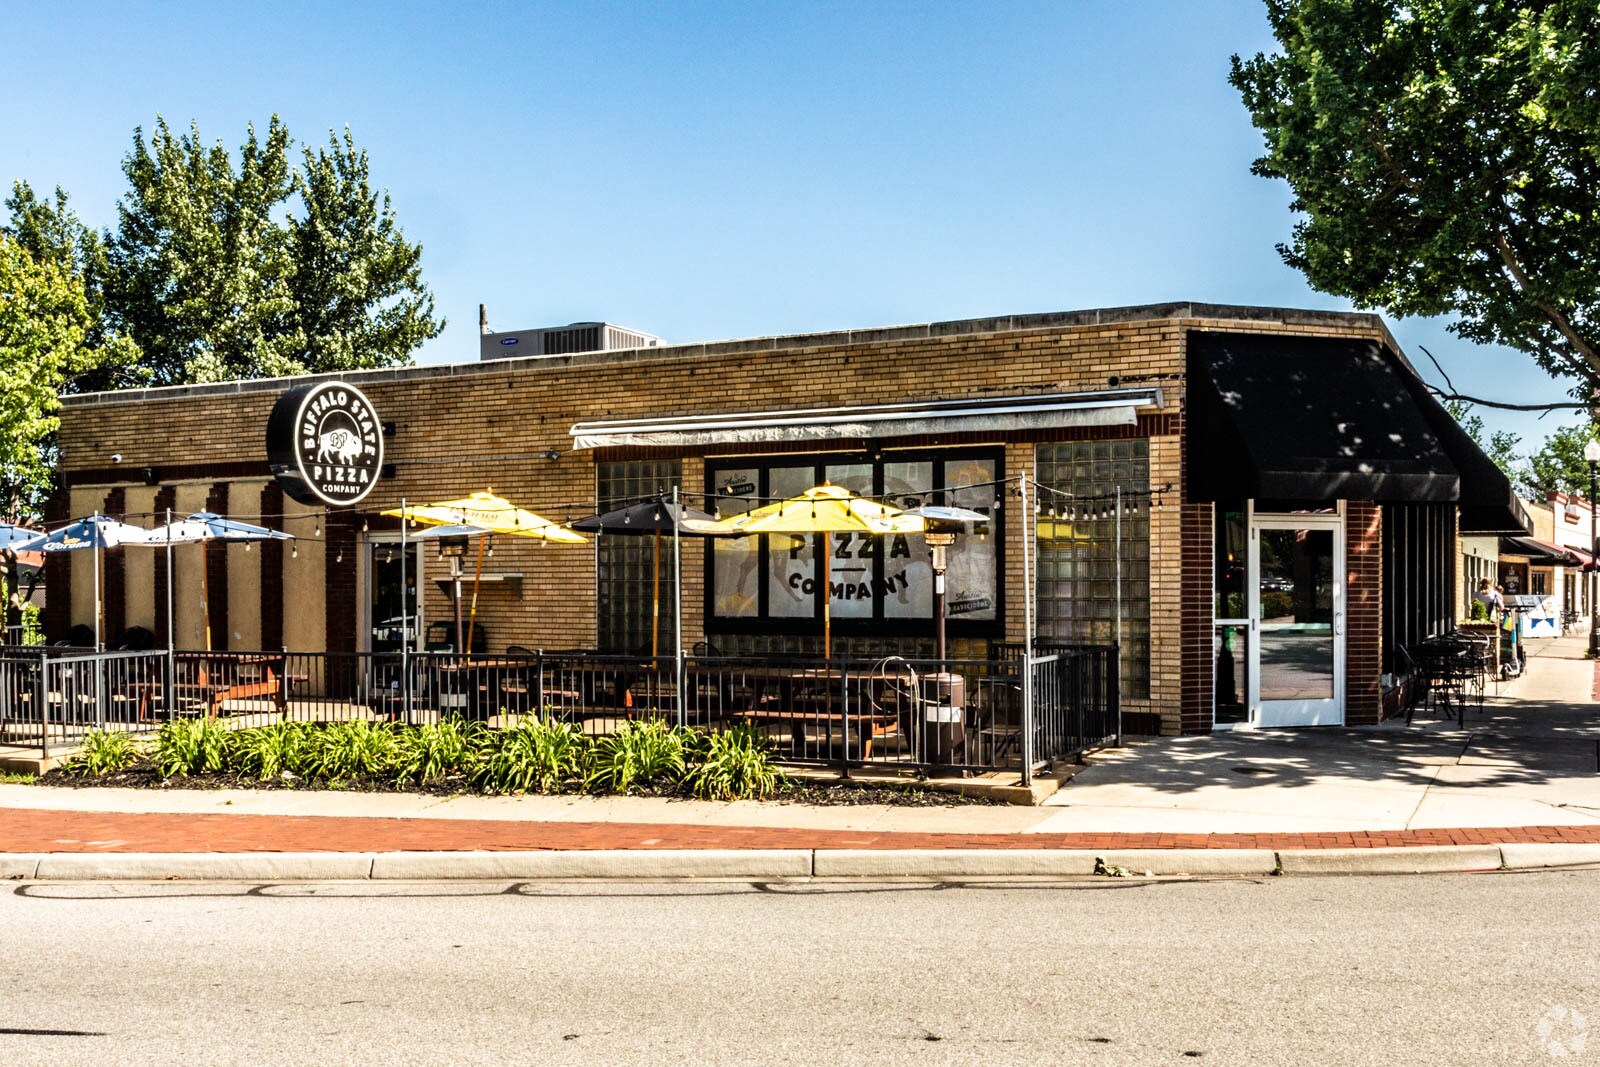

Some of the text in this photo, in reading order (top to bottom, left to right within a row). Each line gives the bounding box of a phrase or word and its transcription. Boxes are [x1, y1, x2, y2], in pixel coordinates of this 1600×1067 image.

[303, 391, 376, 456] BUFFALO STATE
[314, 466, 369, 483] PIZZA
[322, 484, 361, 494] COMPANY
[43, 540, 92, 552] Corona
[790, 532, 911, 559] PZZA
[788, 569, 909, 600] COMPANY
